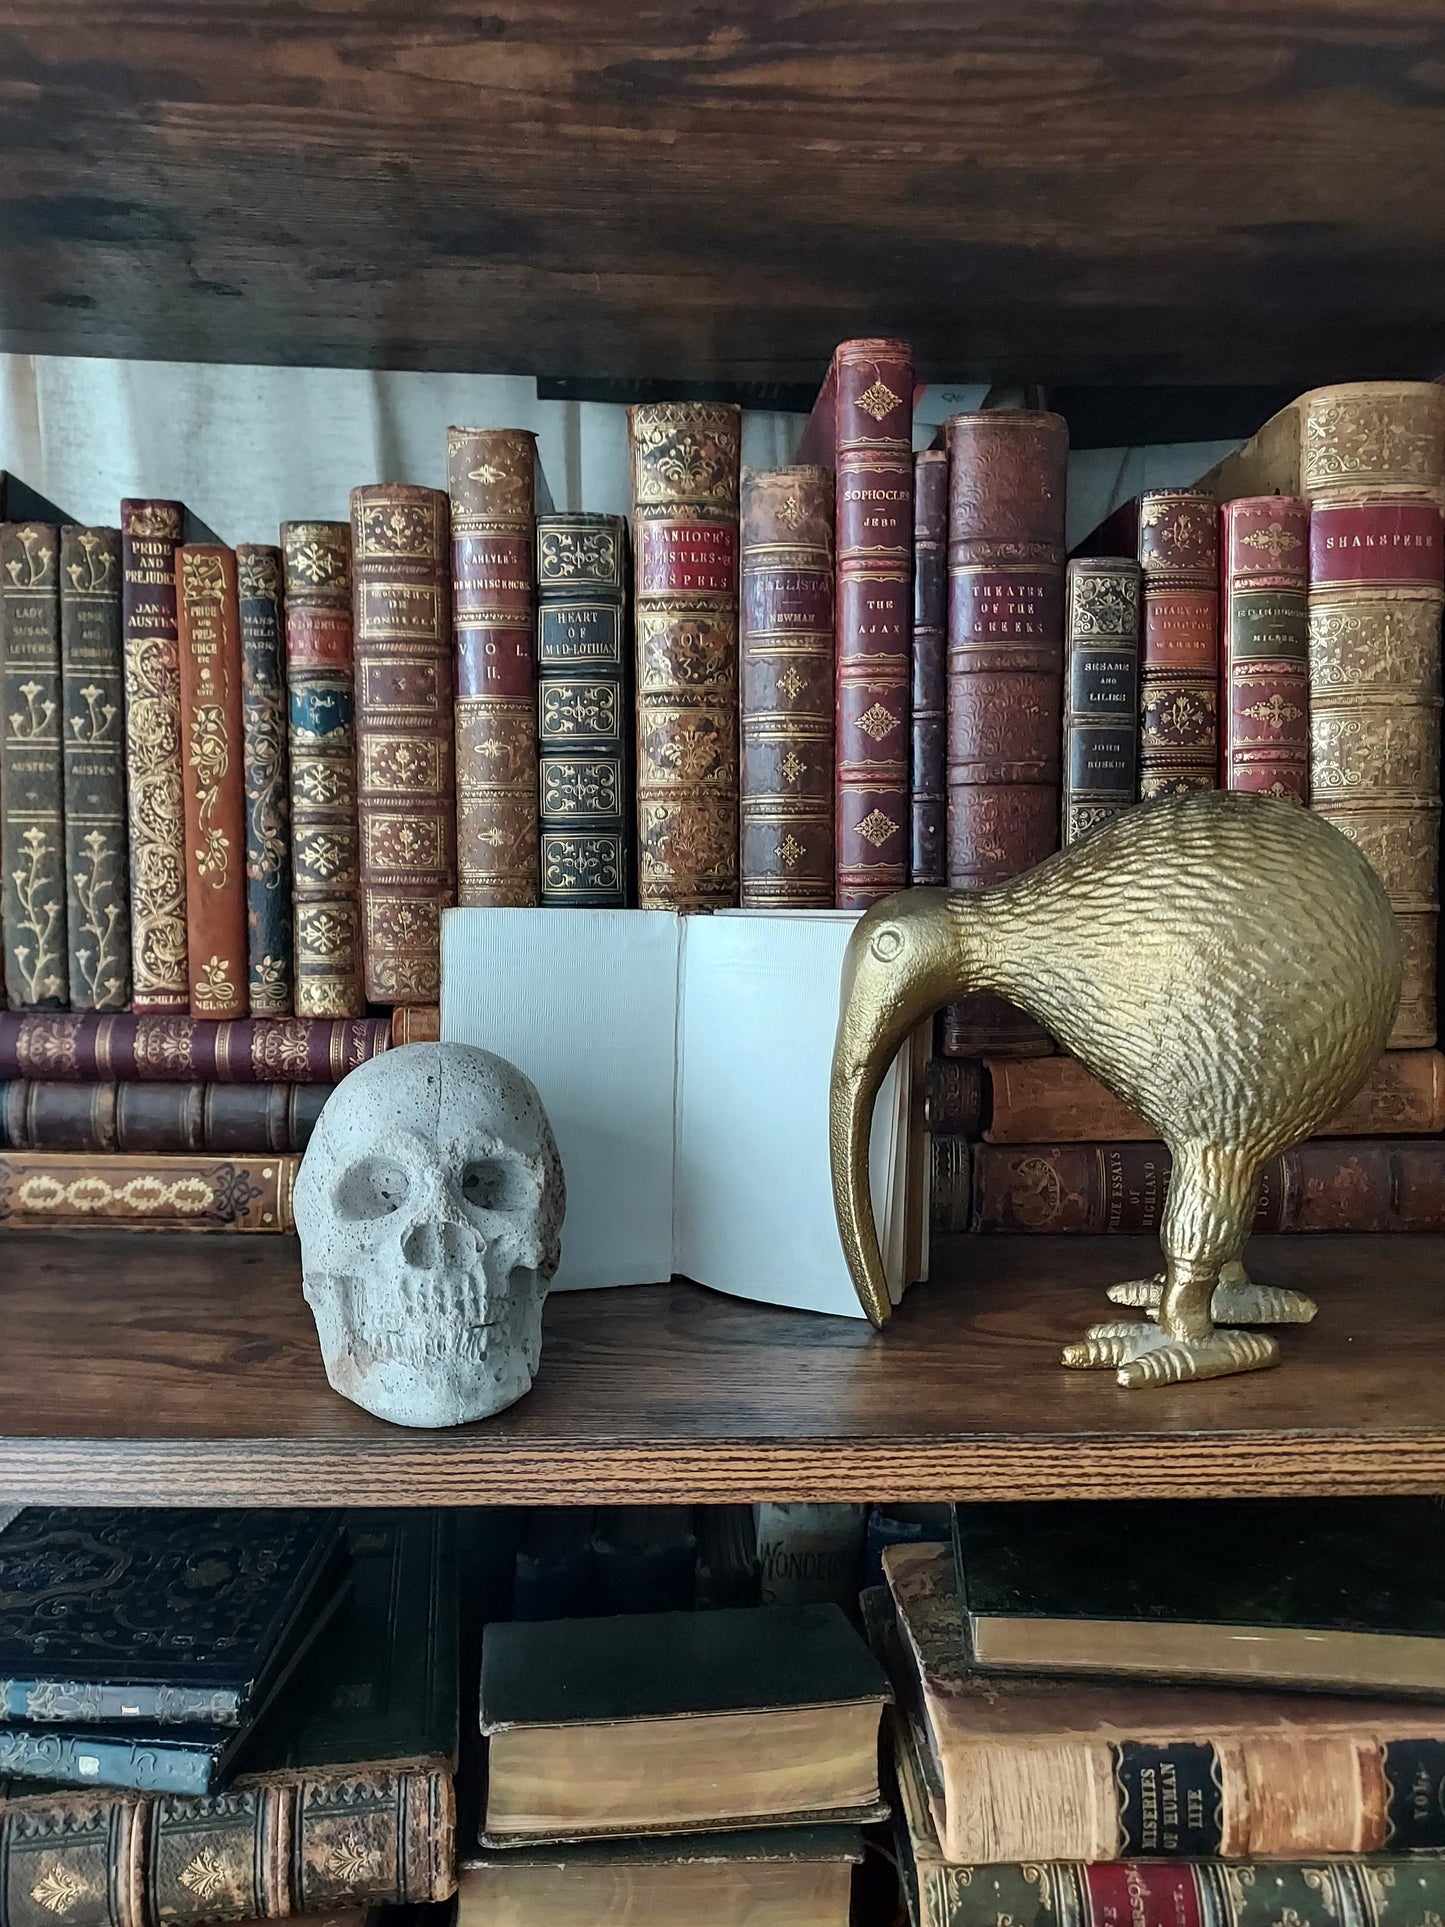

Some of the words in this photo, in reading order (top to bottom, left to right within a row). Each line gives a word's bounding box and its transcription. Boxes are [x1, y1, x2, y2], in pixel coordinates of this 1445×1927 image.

[844, 489, 910, 501] SOPHOCLES
[1325, 533, 1433, 550] SHAKSPERE
[131, 541, 172, 556] PRIDE
[139, 557, 164, 569] AND
[644, 573, 727, 588] GOSPELS
[971, 585, 1044, 598] THEATRE
[135, 603, 171, 615] JANE
[866, 600, 894, 610] THE
[980, 602, 1000, 614] OF
[1007, 602, 1035, 615] THE
[1154, 606, 1192, 616] DIARY
[190, 606, 218, 618] PRIDE
[556, 611, 598, 624] HEART
[769, 613, 816, 623] NEWMAN
[243, 627, 275, 638] FIELD
[567, 626, 587, 639] OF
[858, 624, 900, 635] AJAX
[973, 620, 1045, 633] GREEKS
[190, 642, 218, 655] UDICE
[244, 640, 276, 651] PARK
[459, 643, 529, 658] VOL.
[486, 665, 501, 680] II.
[1084, 661, 1131, 672] SESAME
[1100, 677, 1117, 685] AND
[1091, 743, 1121, 753] JOHN
[10, 761, 55, 773] AUSTEN
[1086, 760, 1126, 769] RUSKIN
[70, 765, 116, 777] AUSTEN
[133, 994, 189, 1005] MACMILLAN
[194, 999, 240, 1011] NELSON
[249, 999, 290, 1010] NELSON
[1110, 1151, 1124, 1198] ESSAYS
[1128, 1188, 1141, 1205] OF
[1142, 1161, 1157, 1227] HIGHLAND
[1159, 1762, 1179, 1826] HUMAN
[1140, 1768, 1158, 1850] MISERIES
[1186, 1788, 1204, 1829] LIFE
[1163, 1831, 1179, 1849] OF
